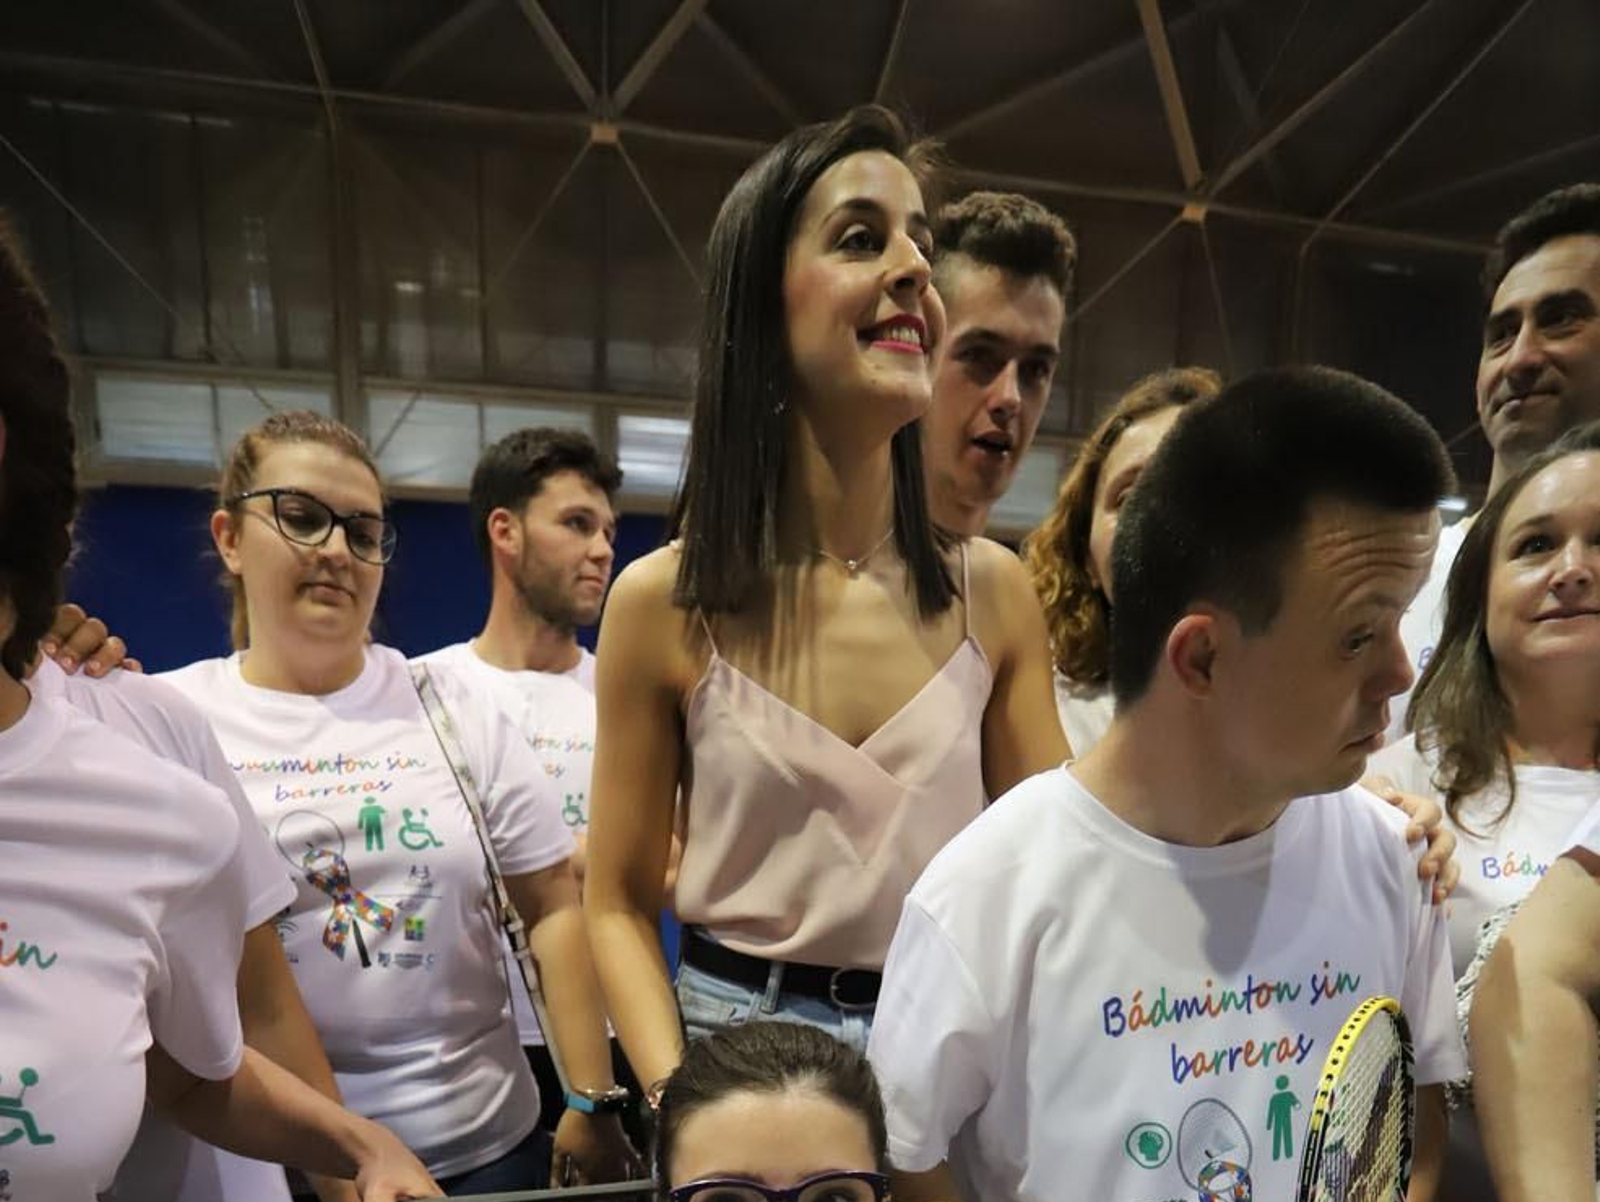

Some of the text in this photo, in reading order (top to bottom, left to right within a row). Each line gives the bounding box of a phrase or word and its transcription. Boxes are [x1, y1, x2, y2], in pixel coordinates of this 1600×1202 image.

[387, 751, 426, 773] sin
[274, 780, 393, 801] barreras
[1102, 960, 1361, 1038] Bádminton sin
[1170, 1033, 1315, 1084] barreras
